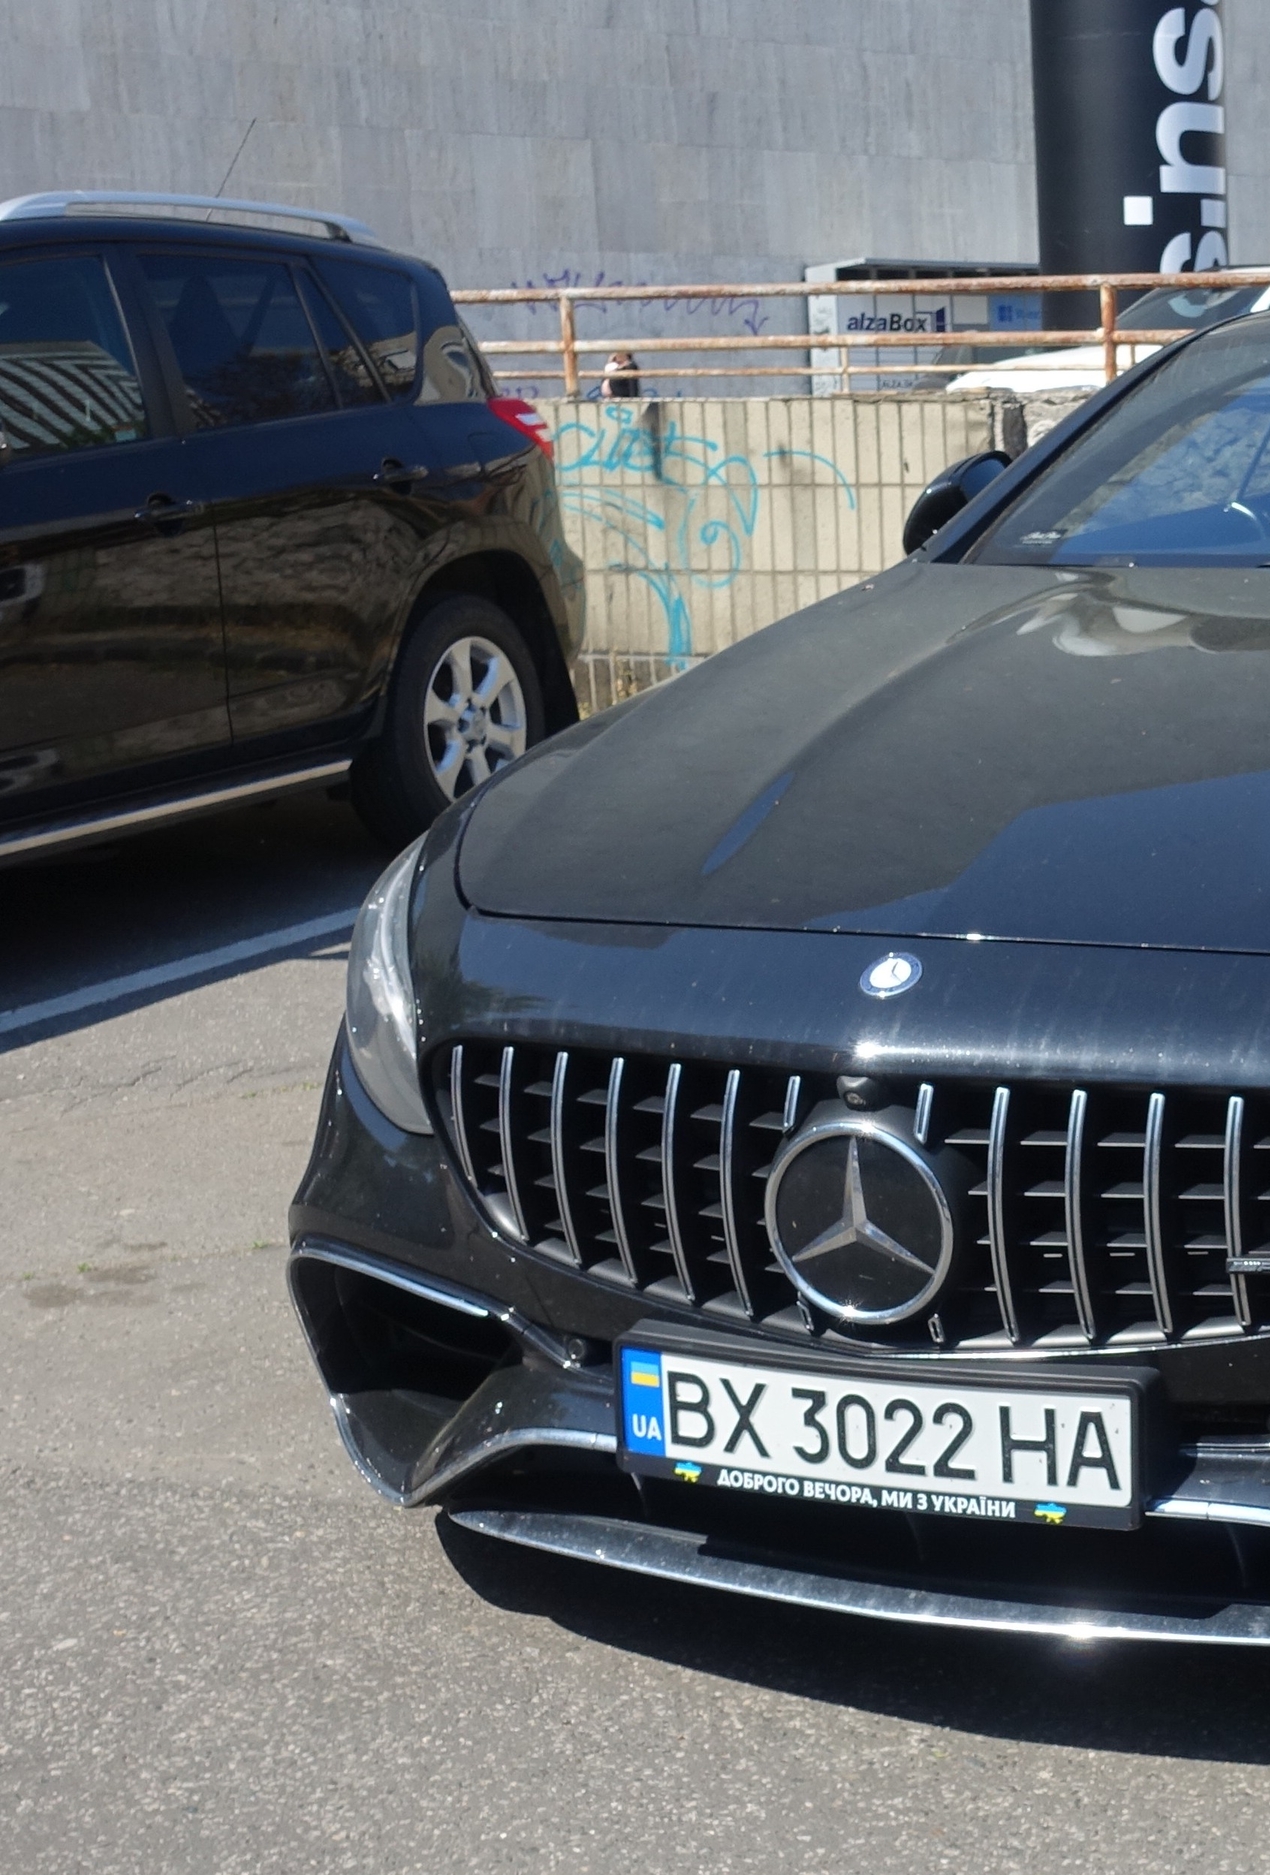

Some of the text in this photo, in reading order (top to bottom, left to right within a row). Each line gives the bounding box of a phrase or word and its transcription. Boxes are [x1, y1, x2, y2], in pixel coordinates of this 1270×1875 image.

[847, 312, 928, 332] alzaBox
[632, 1413, 662, 1441] UA
[667, 1370, 1121, 1490] BX 3022 HA
[716, 1468, 1016, 1518] ДОБРОГО ВЕЧОРА, МИ З УКРАЇНИ
